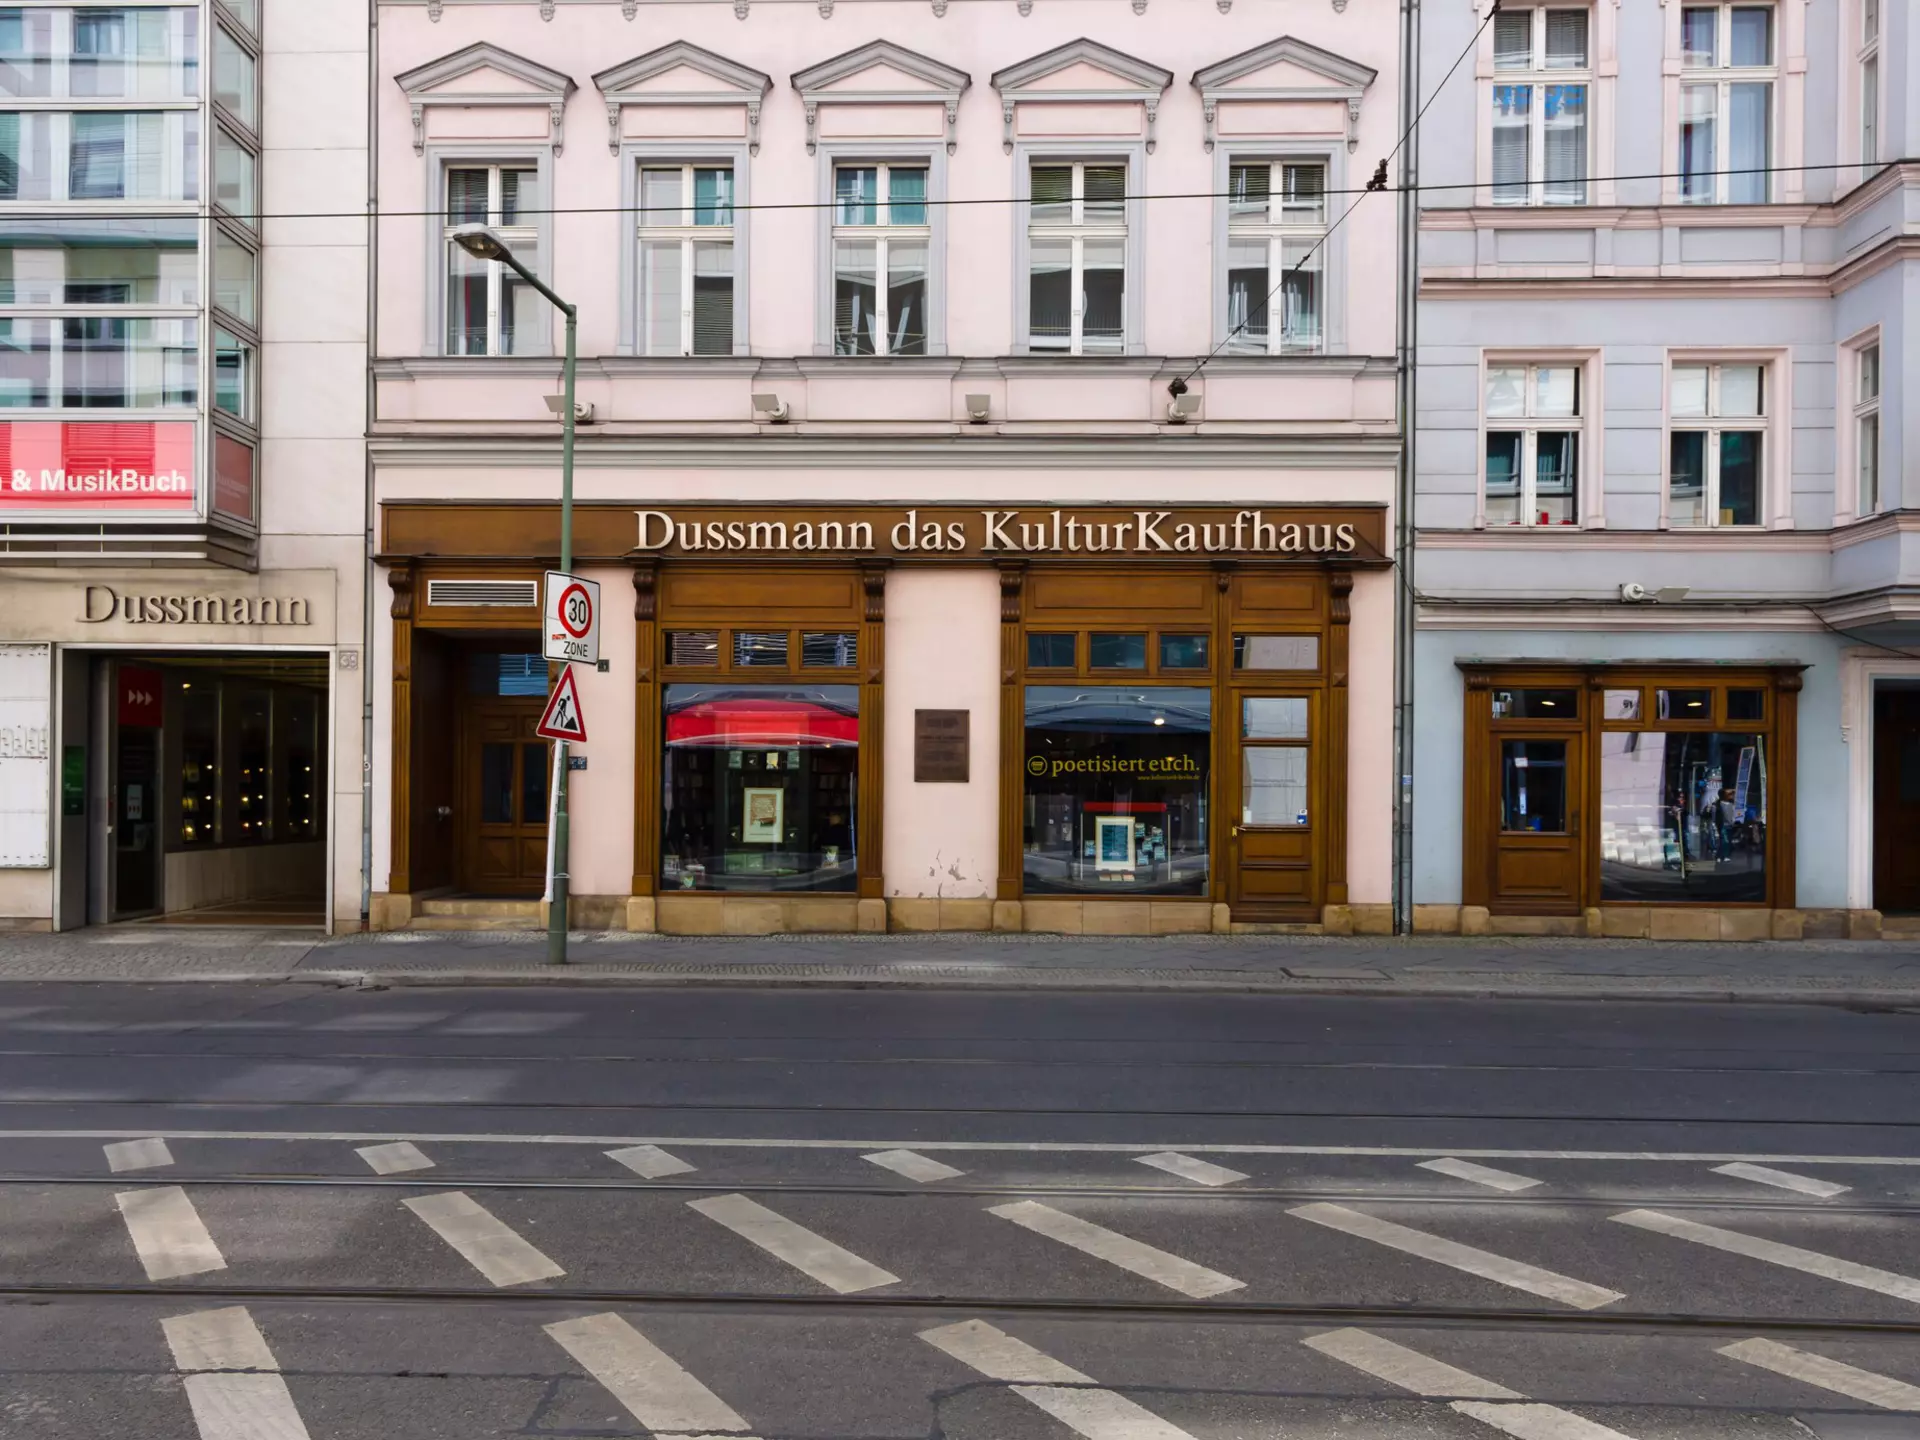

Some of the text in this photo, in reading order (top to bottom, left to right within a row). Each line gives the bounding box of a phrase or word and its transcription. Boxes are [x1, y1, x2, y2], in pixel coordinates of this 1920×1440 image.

[11, 469, 32, 492] &
[40, 469, 187, 492] MusikBuch
[633, 510, 1355, 552] Dussmann das KulturKaufhaus
[77, 585, 310, 625] Dussmann
[568, 597, 587, 625] 30
[563, 641, 588, 657] ZONE
[1052, 754, 1201, 777] poetisiert euch.
